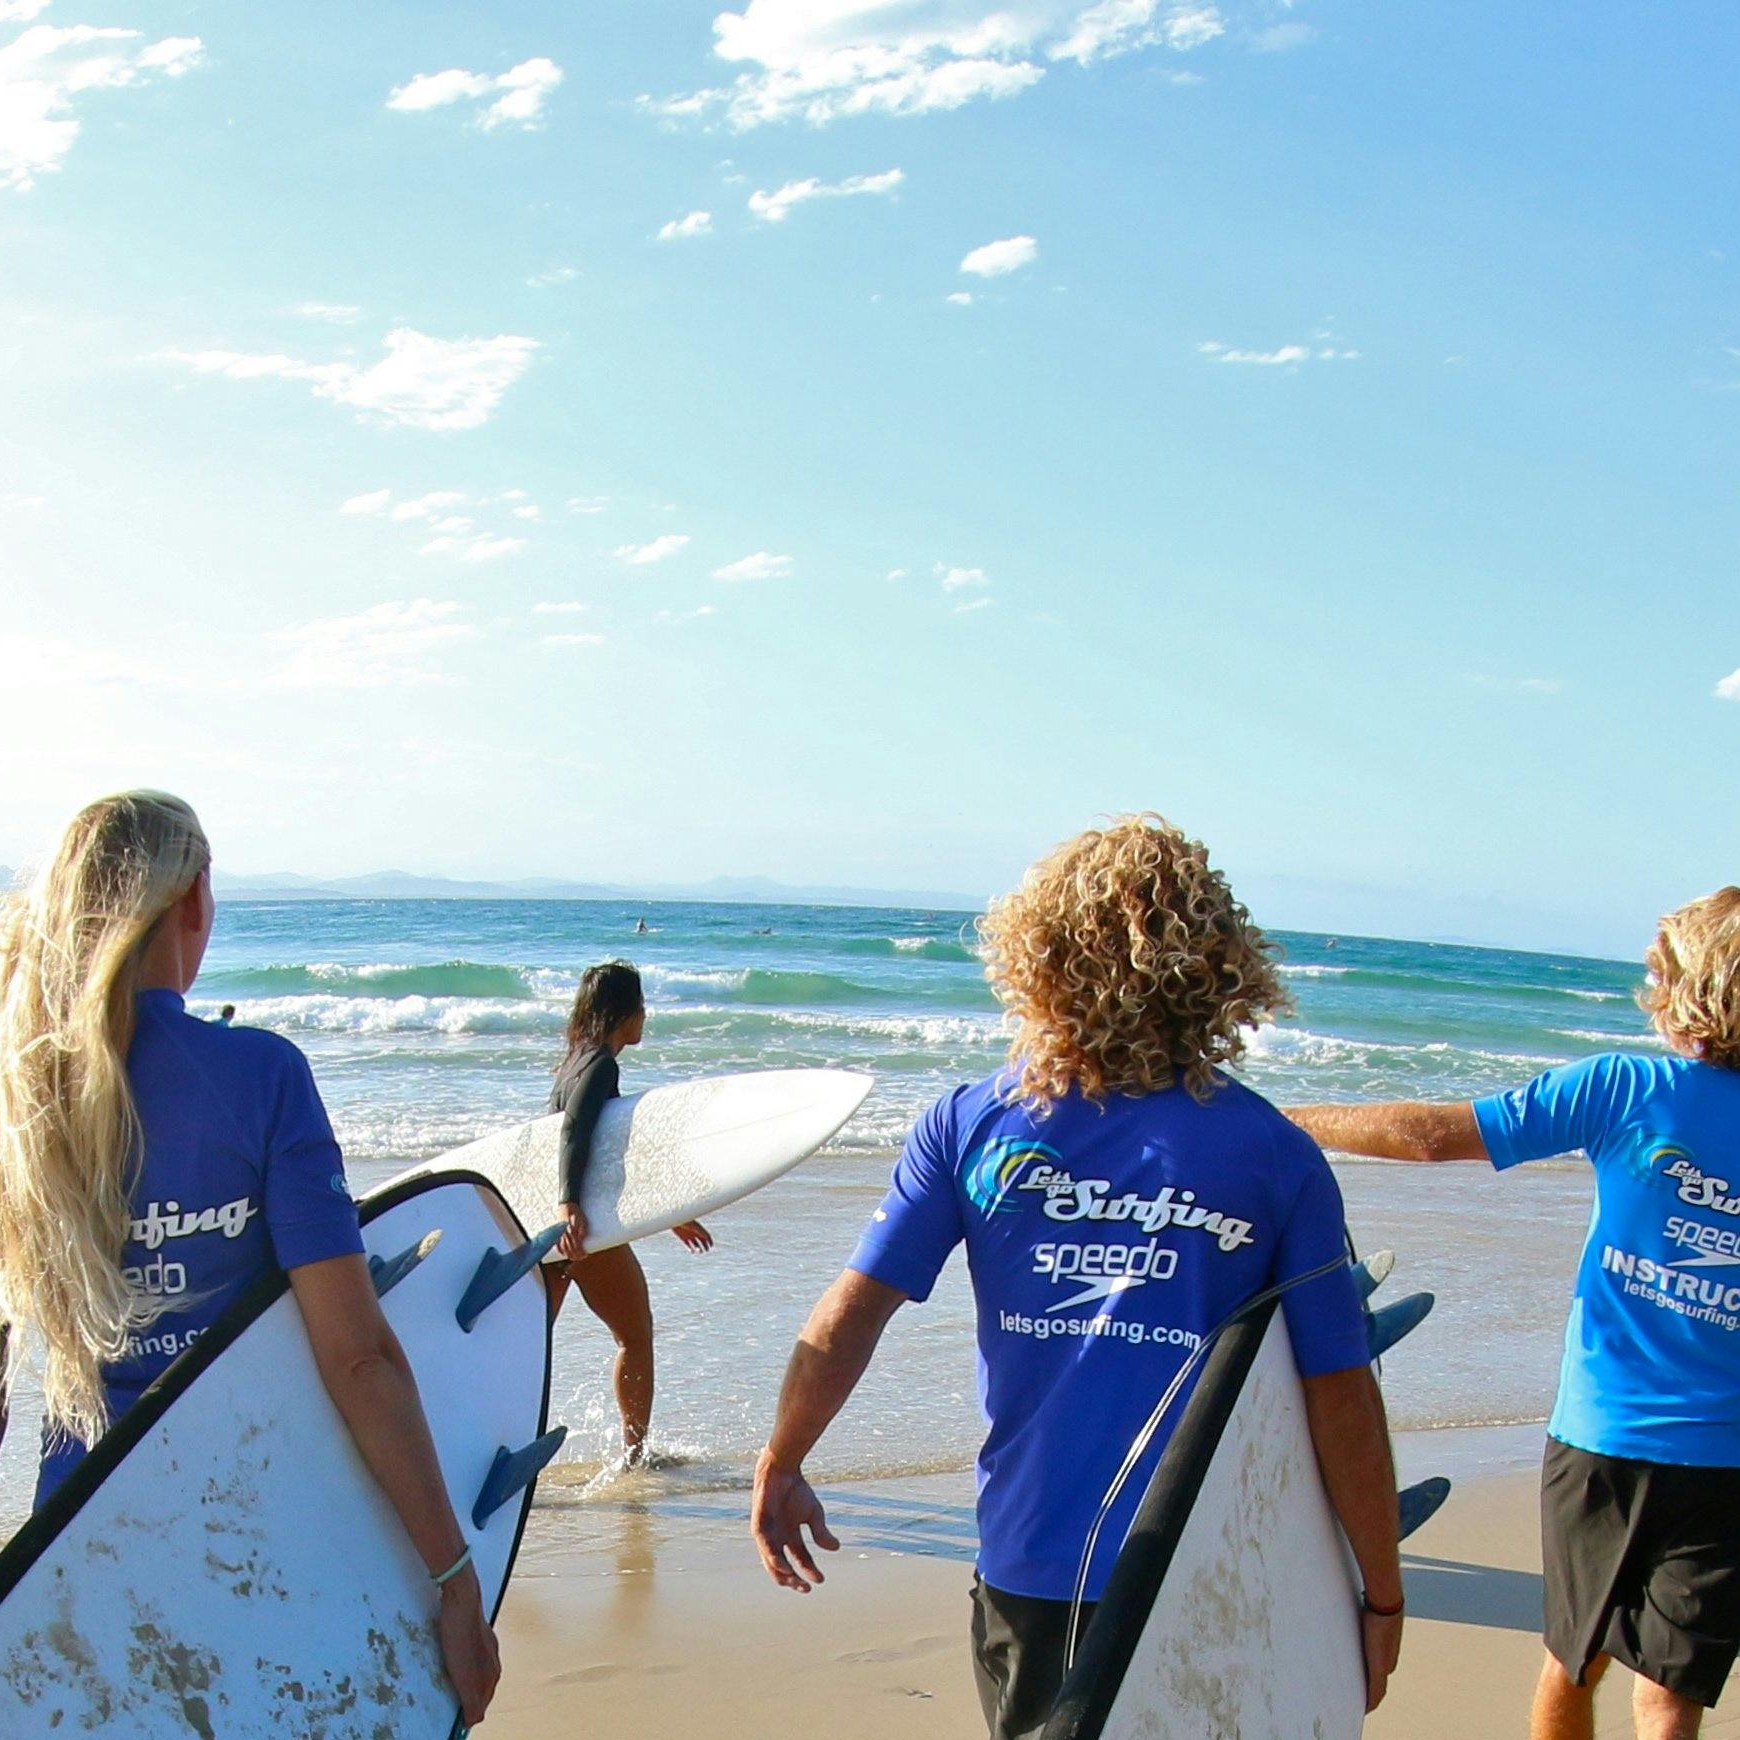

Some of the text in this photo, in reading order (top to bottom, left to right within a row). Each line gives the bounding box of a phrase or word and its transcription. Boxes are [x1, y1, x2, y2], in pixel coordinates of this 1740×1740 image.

[1017, 1165, 1076, 1190] Lets
[128, 1197, 258, 1250] rfing
[1043, 1179, 1254, 1252] Surfing
[120, 1253, 187, 1294] edo
[1032, 1237, 1179, 1284] speedo
[999, 1310, 1202, 1351] letsgosurfing.com
